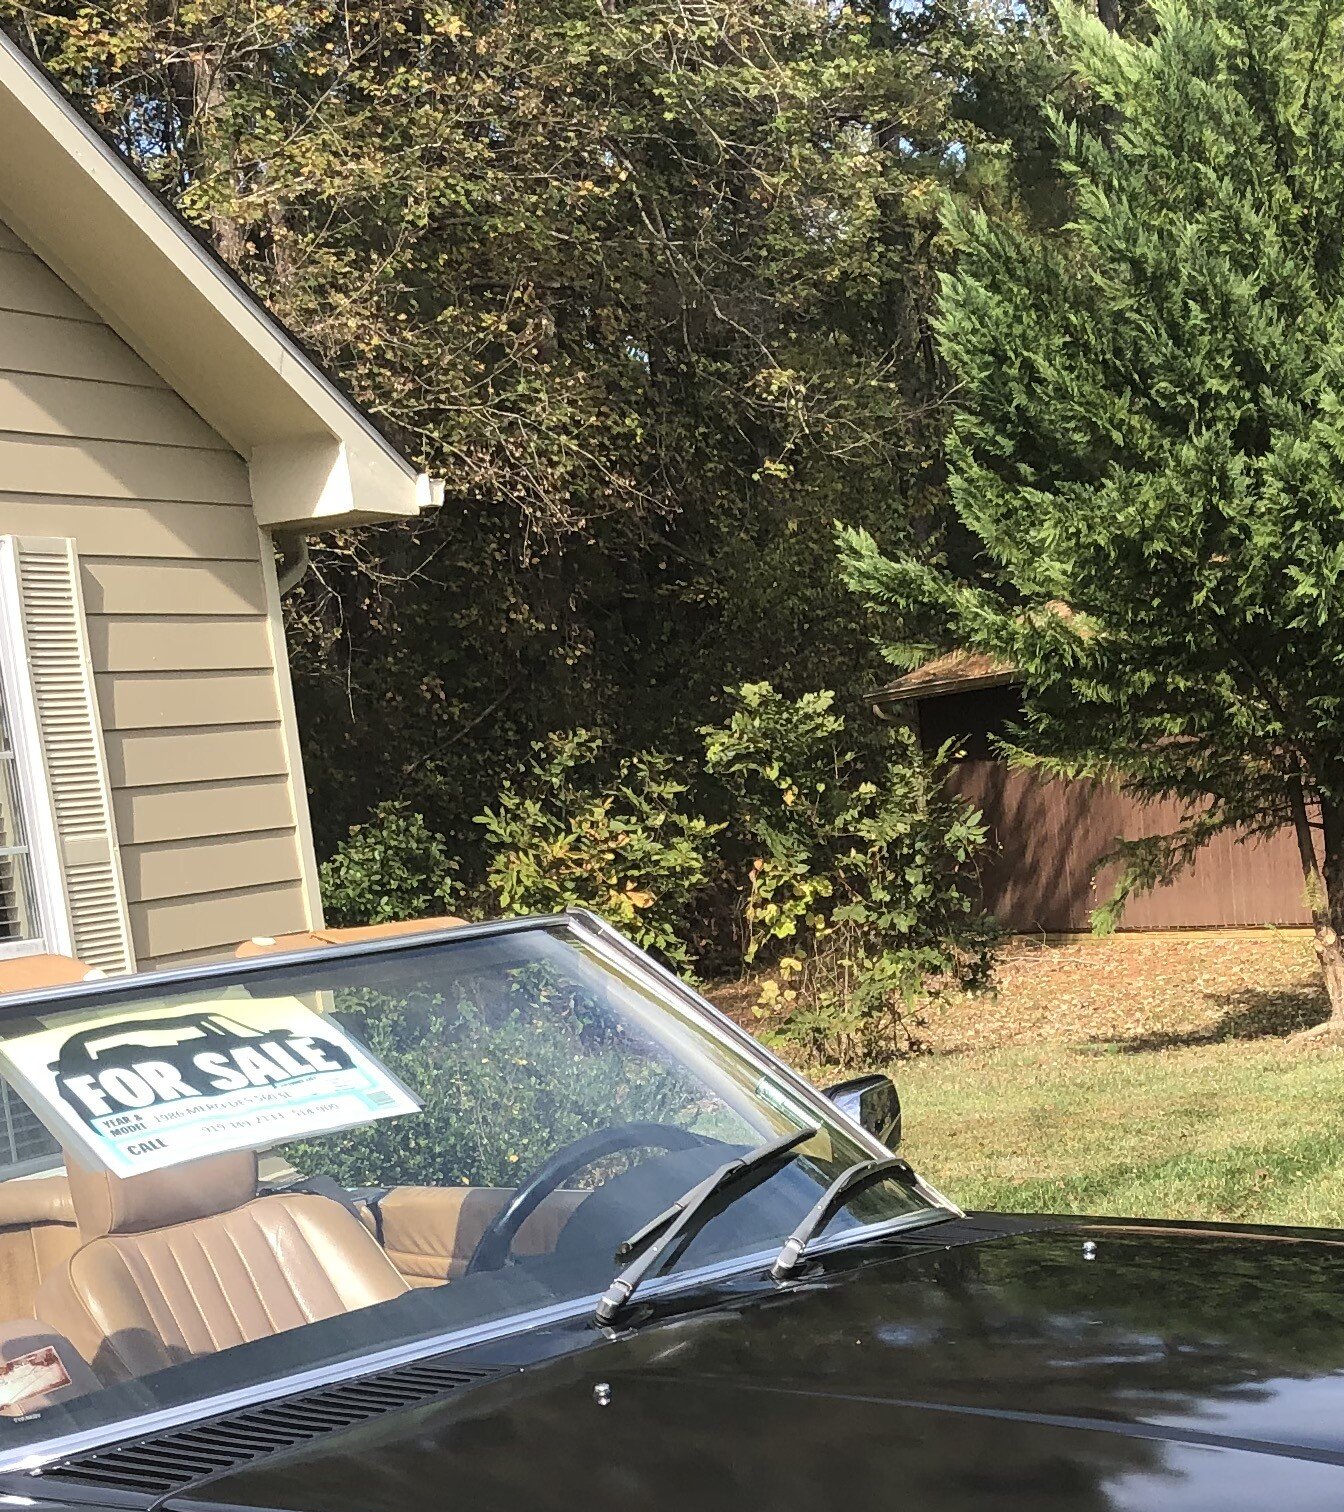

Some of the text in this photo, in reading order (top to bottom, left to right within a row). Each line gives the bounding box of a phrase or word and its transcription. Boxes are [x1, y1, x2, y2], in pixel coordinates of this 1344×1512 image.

[63, 1036, 342, 1117] FOR SALE
[153, 1110, 185, 1123] 1986
[185, 1096, 253, 1115] MERCEDES
[102, 1116, 131, 1128] YEAR
[109, 1122, 148, 1137] MODEL
[201, 1123, 226, 1133] 919
[127, 1138, 168, 1155] CALL
